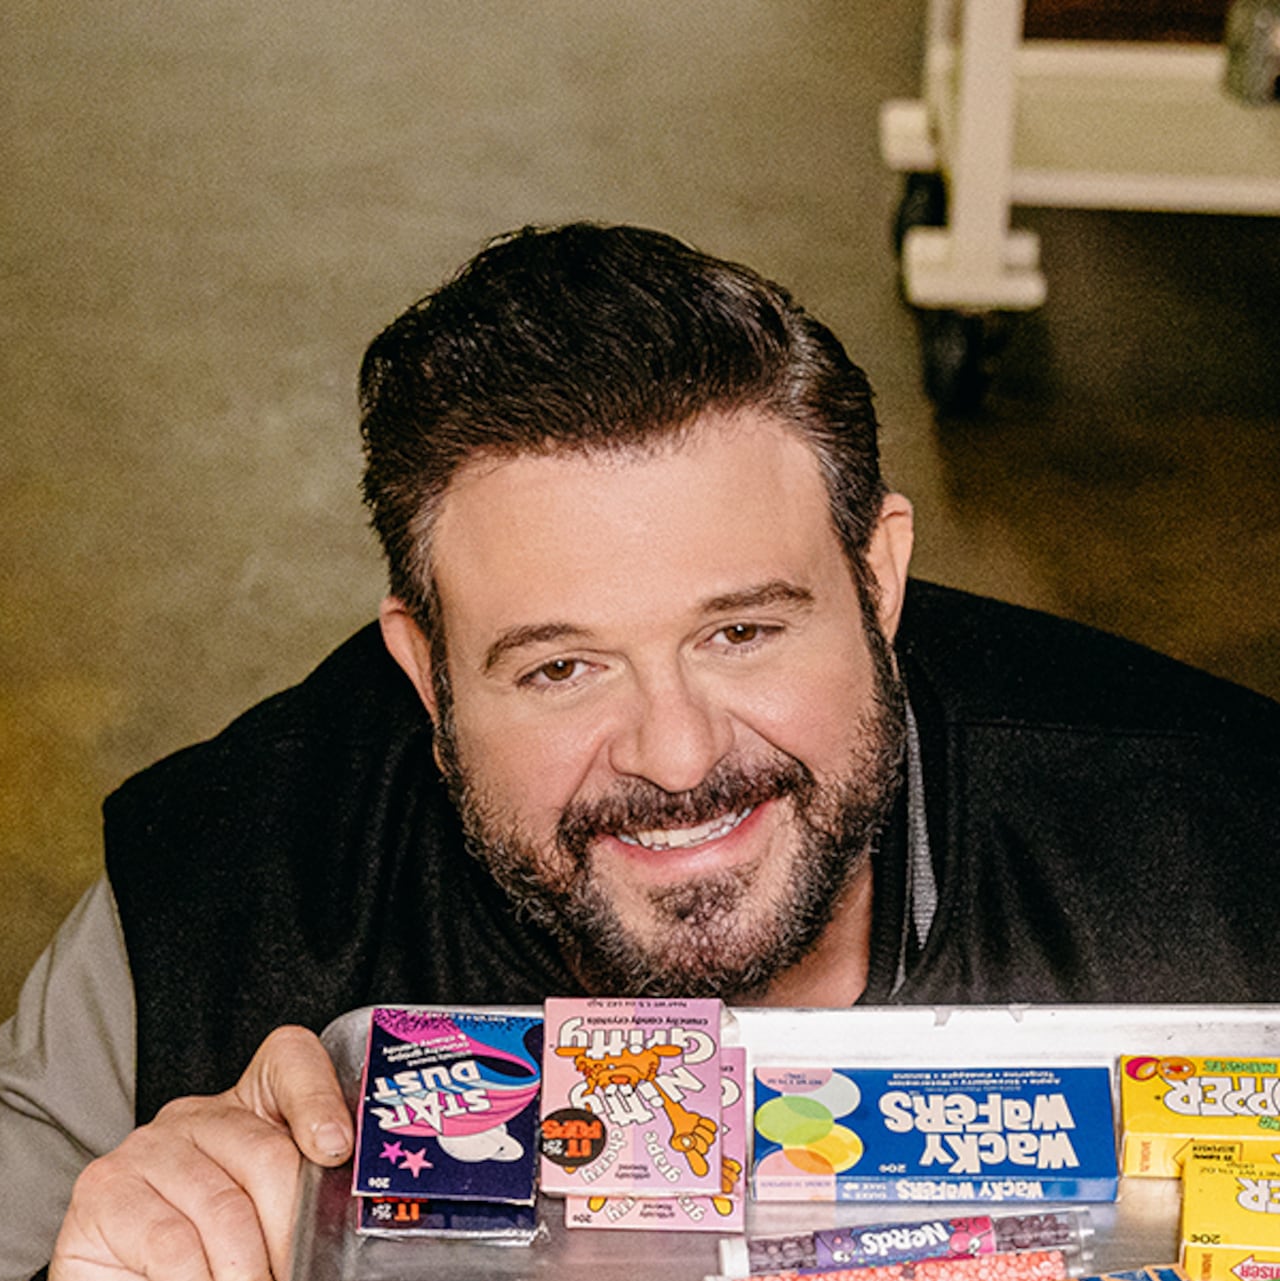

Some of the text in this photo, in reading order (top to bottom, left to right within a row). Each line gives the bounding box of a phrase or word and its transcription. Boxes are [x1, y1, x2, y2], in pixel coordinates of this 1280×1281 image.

[372, 1060, 482, 1100] DUST
[567, 1065, 706, 1127] Nitty
[369, 1089, 492, 1137] STAR
[540, 1119, 602, 1140] POPS
[564, 1138, 592, 1157] IT
[580, 1129, 628, 1185] cherry
[643, 1130, 681, 1184] grape
[394, 1202, 420, 1221] IT
[1191, 1234, 1221, 1245] 20¢
